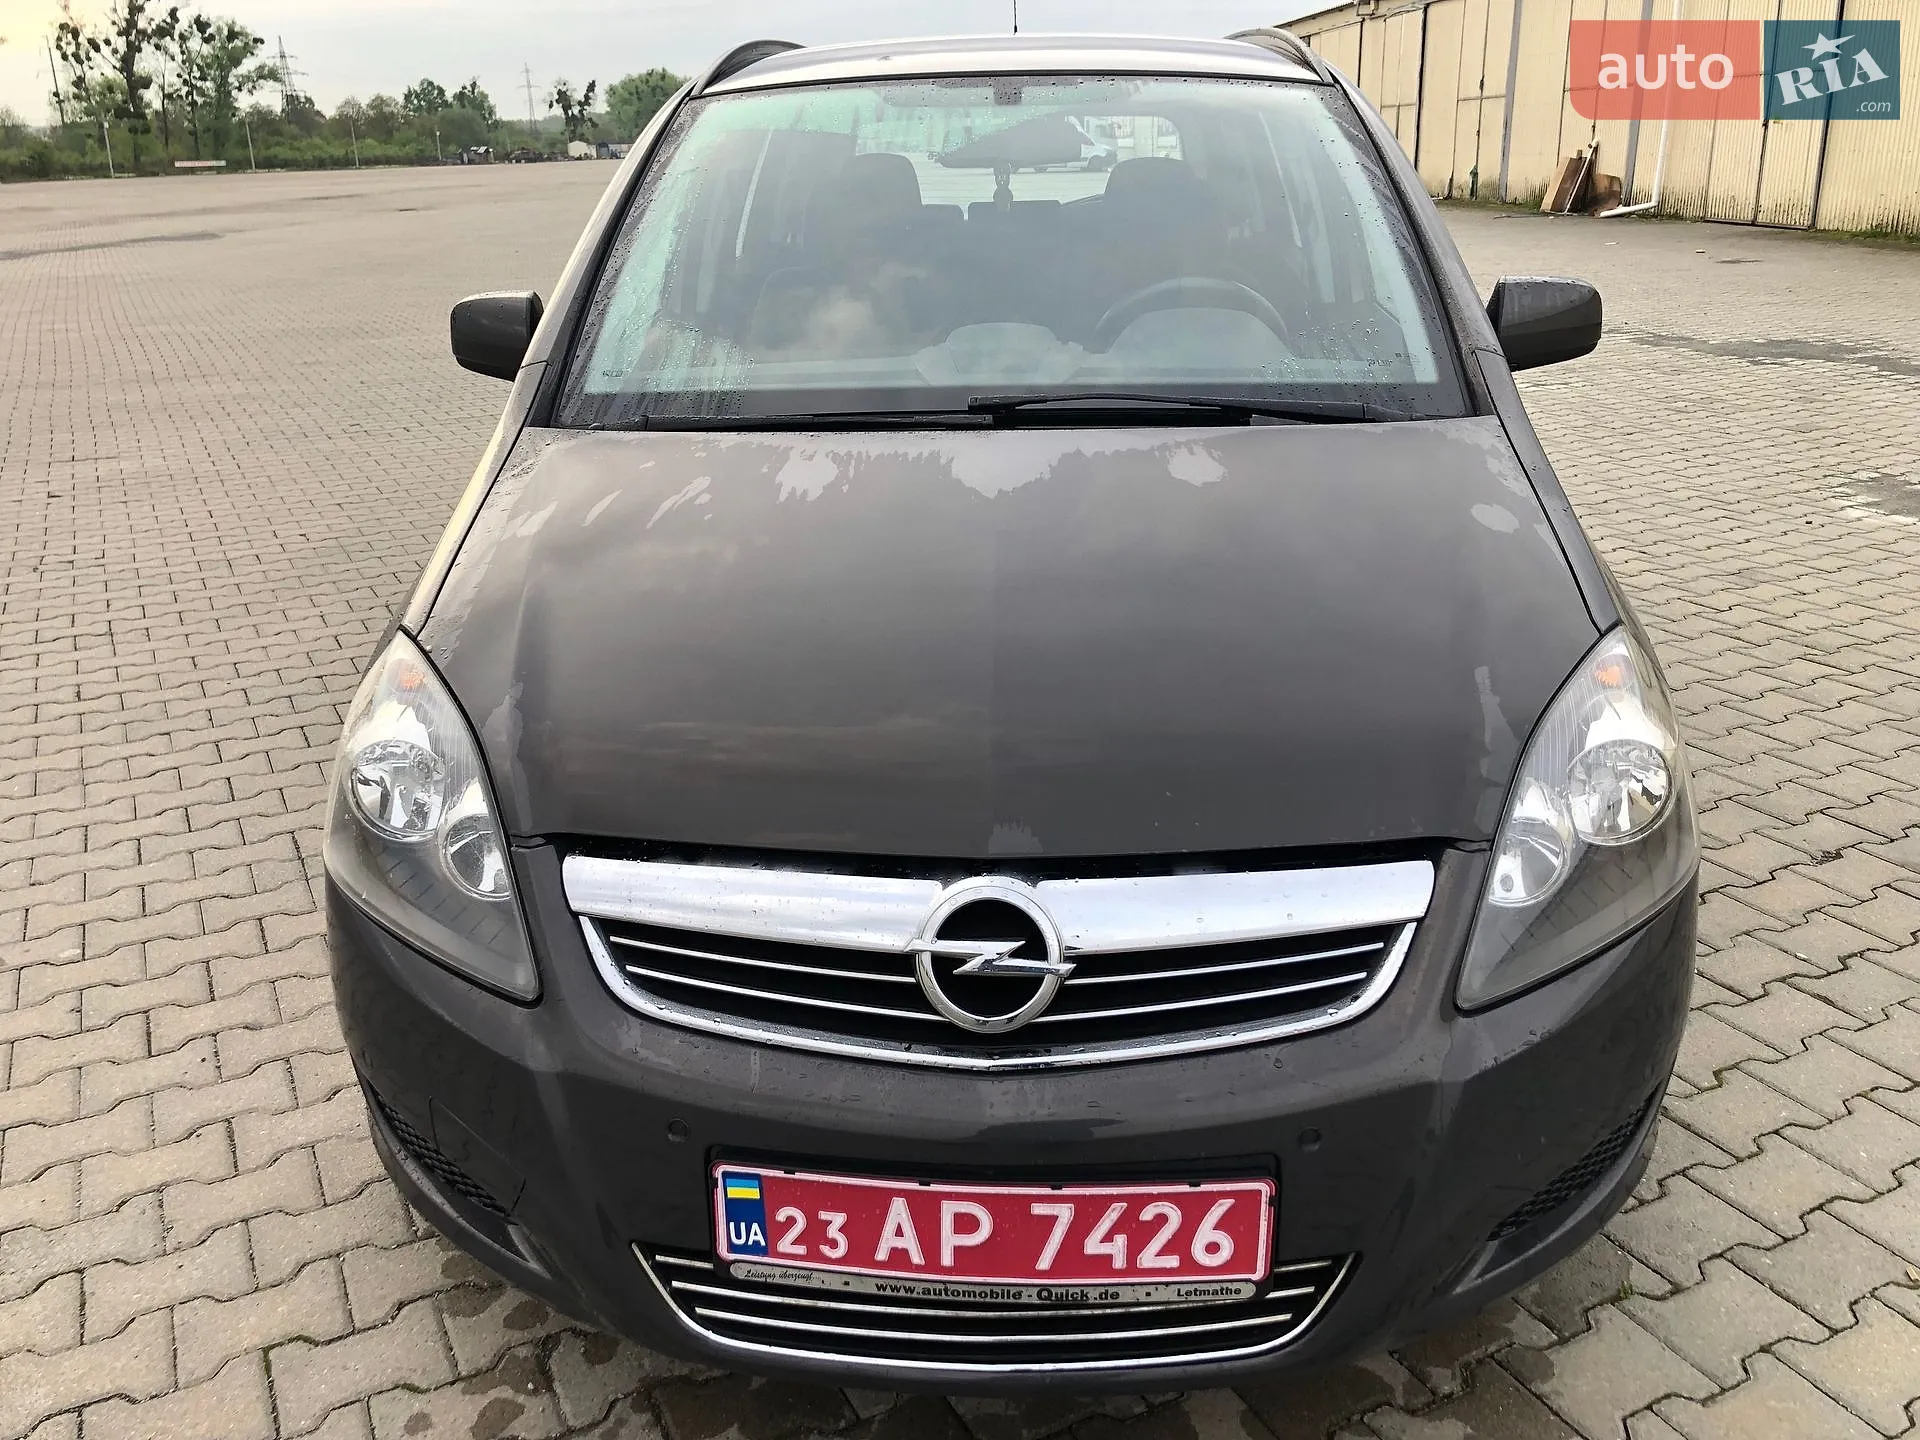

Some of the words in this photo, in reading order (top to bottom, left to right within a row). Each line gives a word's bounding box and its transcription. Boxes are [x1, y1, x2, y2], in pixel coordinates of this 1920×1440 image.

[729, 1221, 766, 1247] UA
[775, 1206, 849, 1259] 23
[874, 1197, 994, 1267] AP
[1030, 1199, 1235, 1270] 7426
[1177, 1287, 1242, 1297] Letmathe
